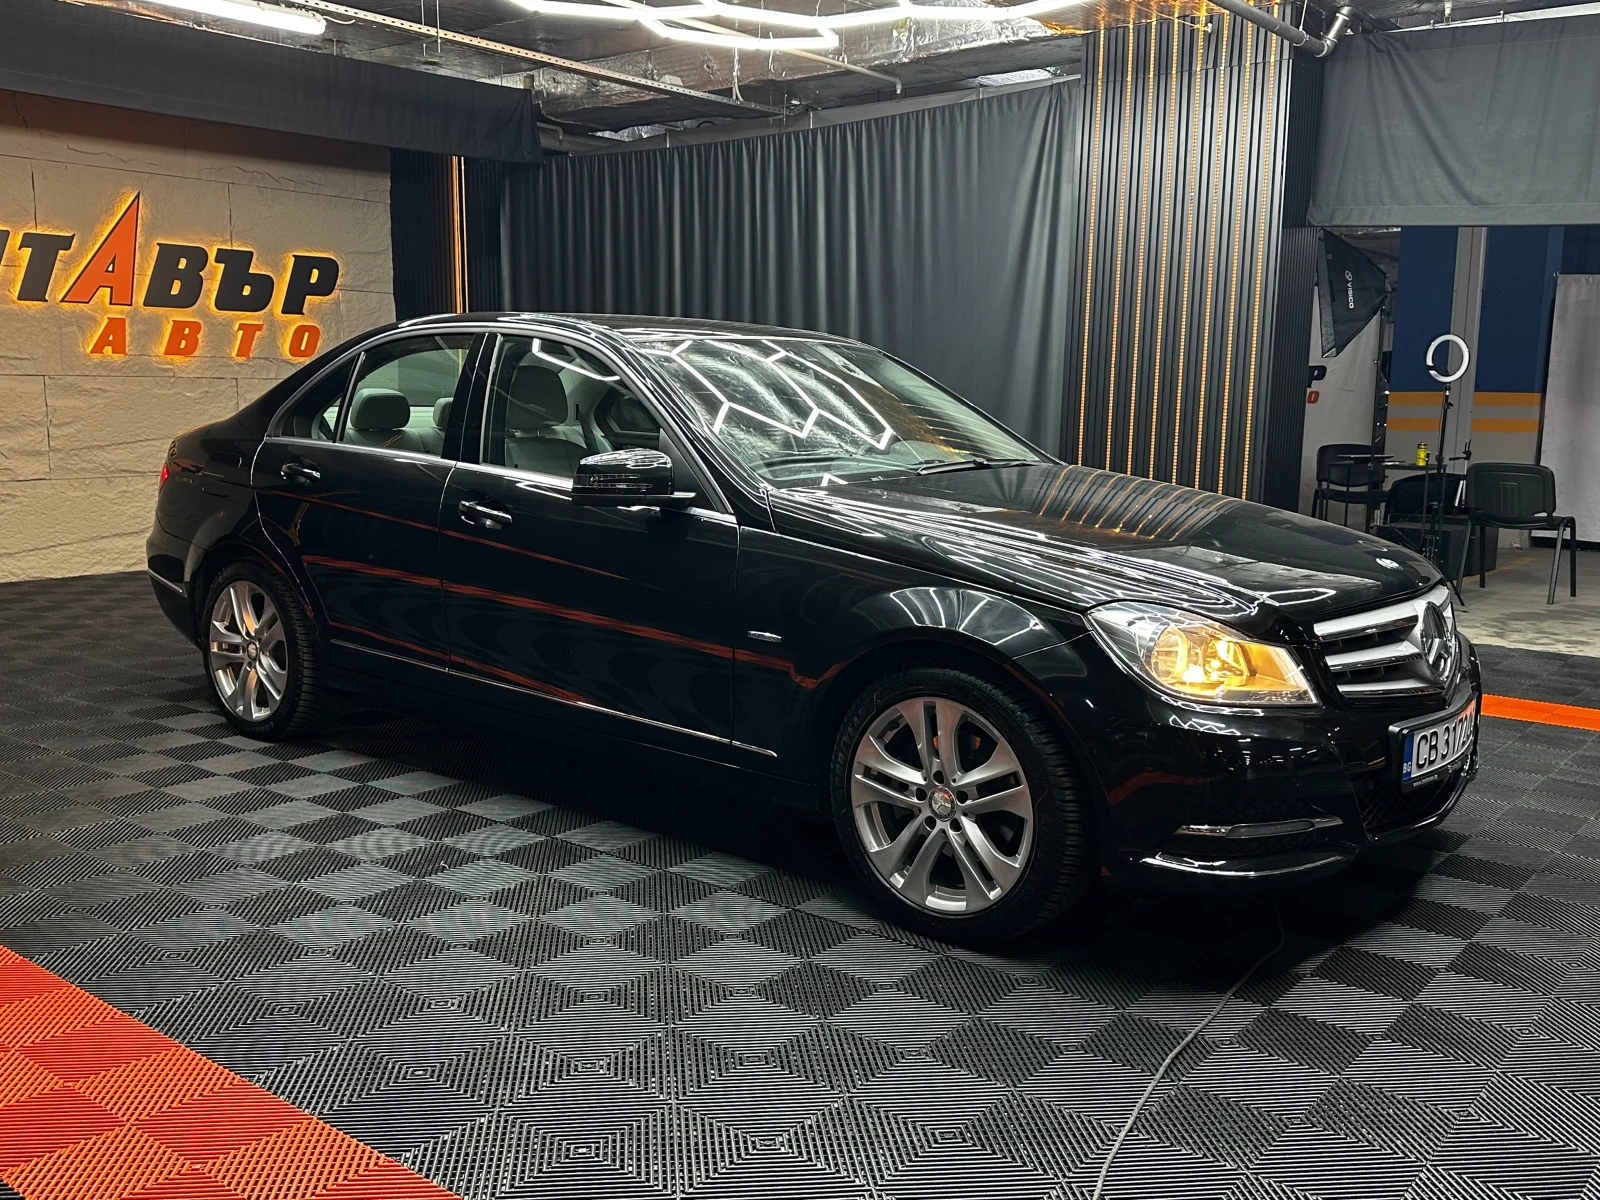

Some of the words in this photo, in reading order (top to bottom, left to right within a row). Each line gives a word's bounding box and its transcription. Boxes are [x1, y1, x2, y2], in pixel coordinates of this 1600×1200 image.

[0, 190, 339, 315] ТАВЪР
[90, 317, 321, 358] АВТО
[1403, 761, 1411, 774] BG
